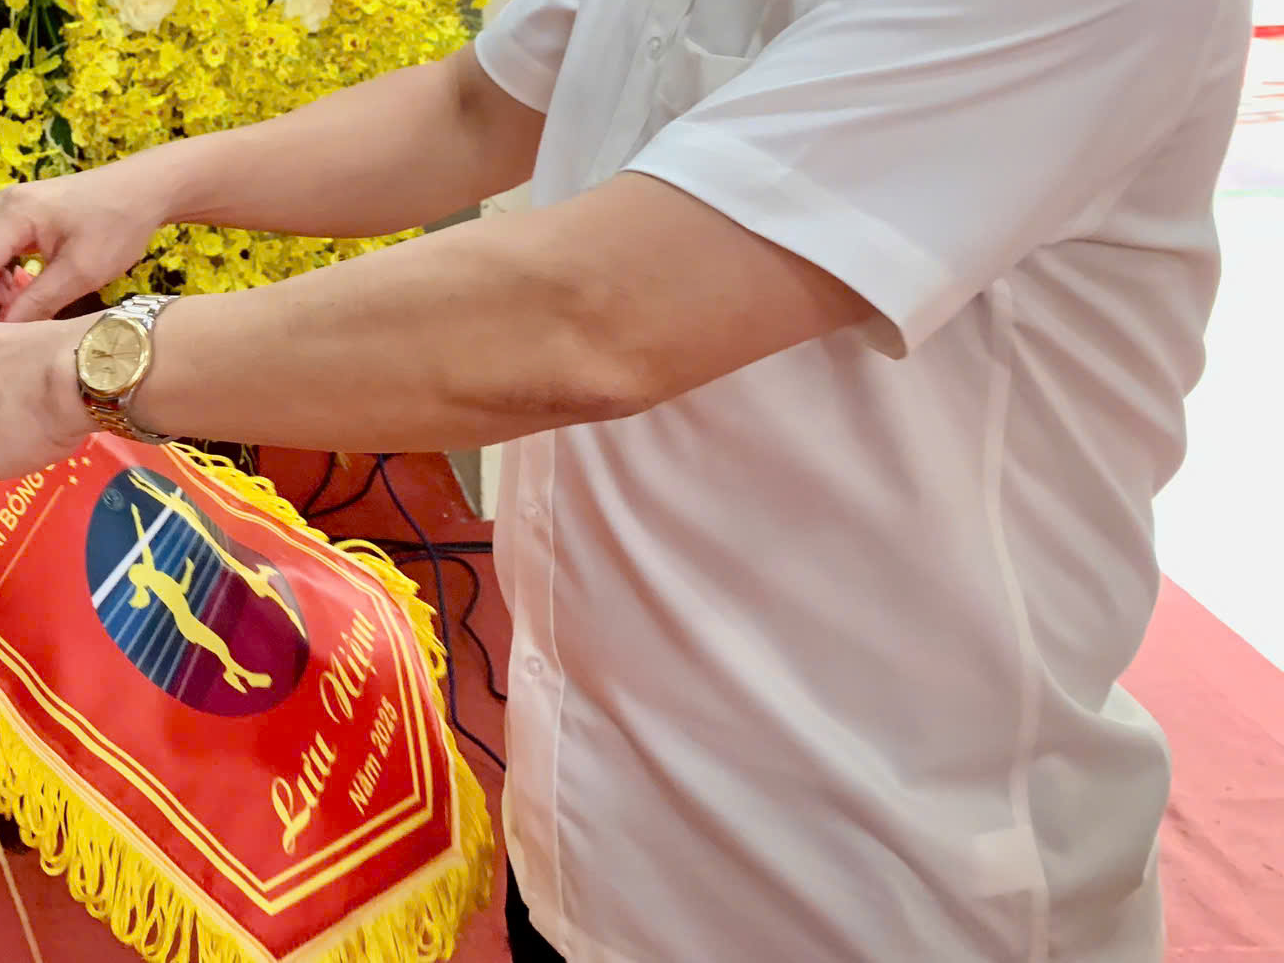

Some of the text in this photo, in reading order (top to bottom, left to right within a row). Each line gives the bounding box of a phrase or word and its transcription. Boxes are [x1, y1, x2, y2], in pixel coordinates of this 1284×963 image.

[271, 608, 378, 855] Lưu Niệm
[348, 752, 382, 816] Năm
